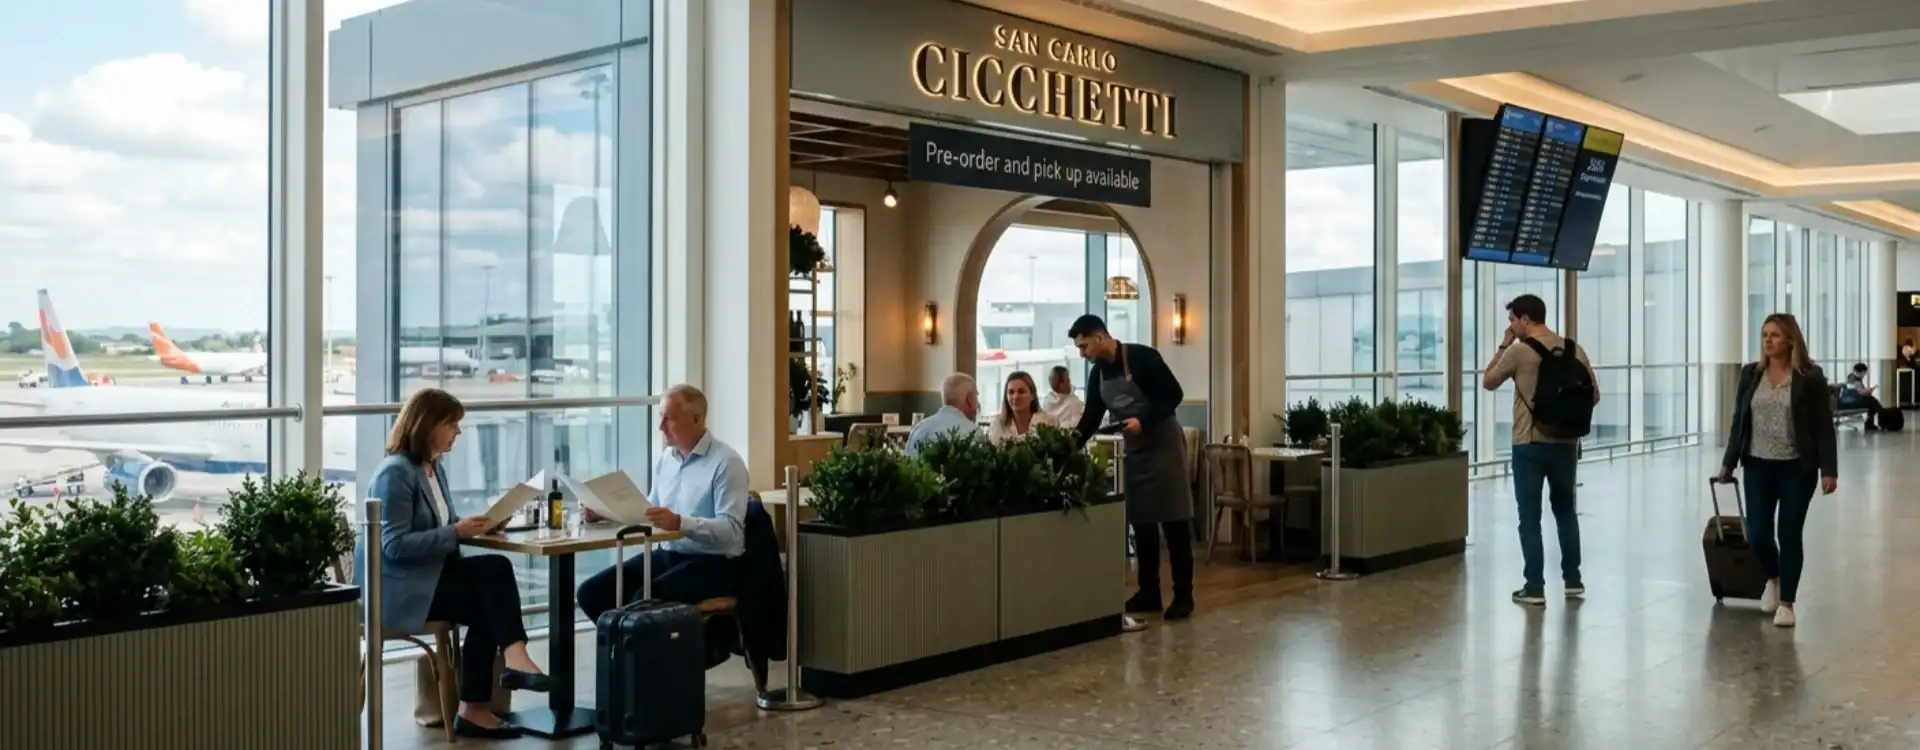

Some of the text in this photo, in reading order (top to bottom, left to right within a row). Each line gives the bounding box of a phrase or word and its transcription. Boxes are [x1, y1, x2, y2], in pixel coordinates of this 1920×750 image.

[994, 24, 1118, 73] SAN CARLO
[912, 42, 1178, 139] CICCHETTI
[926, 141, 1140, 190] Pre-order and pick up available
